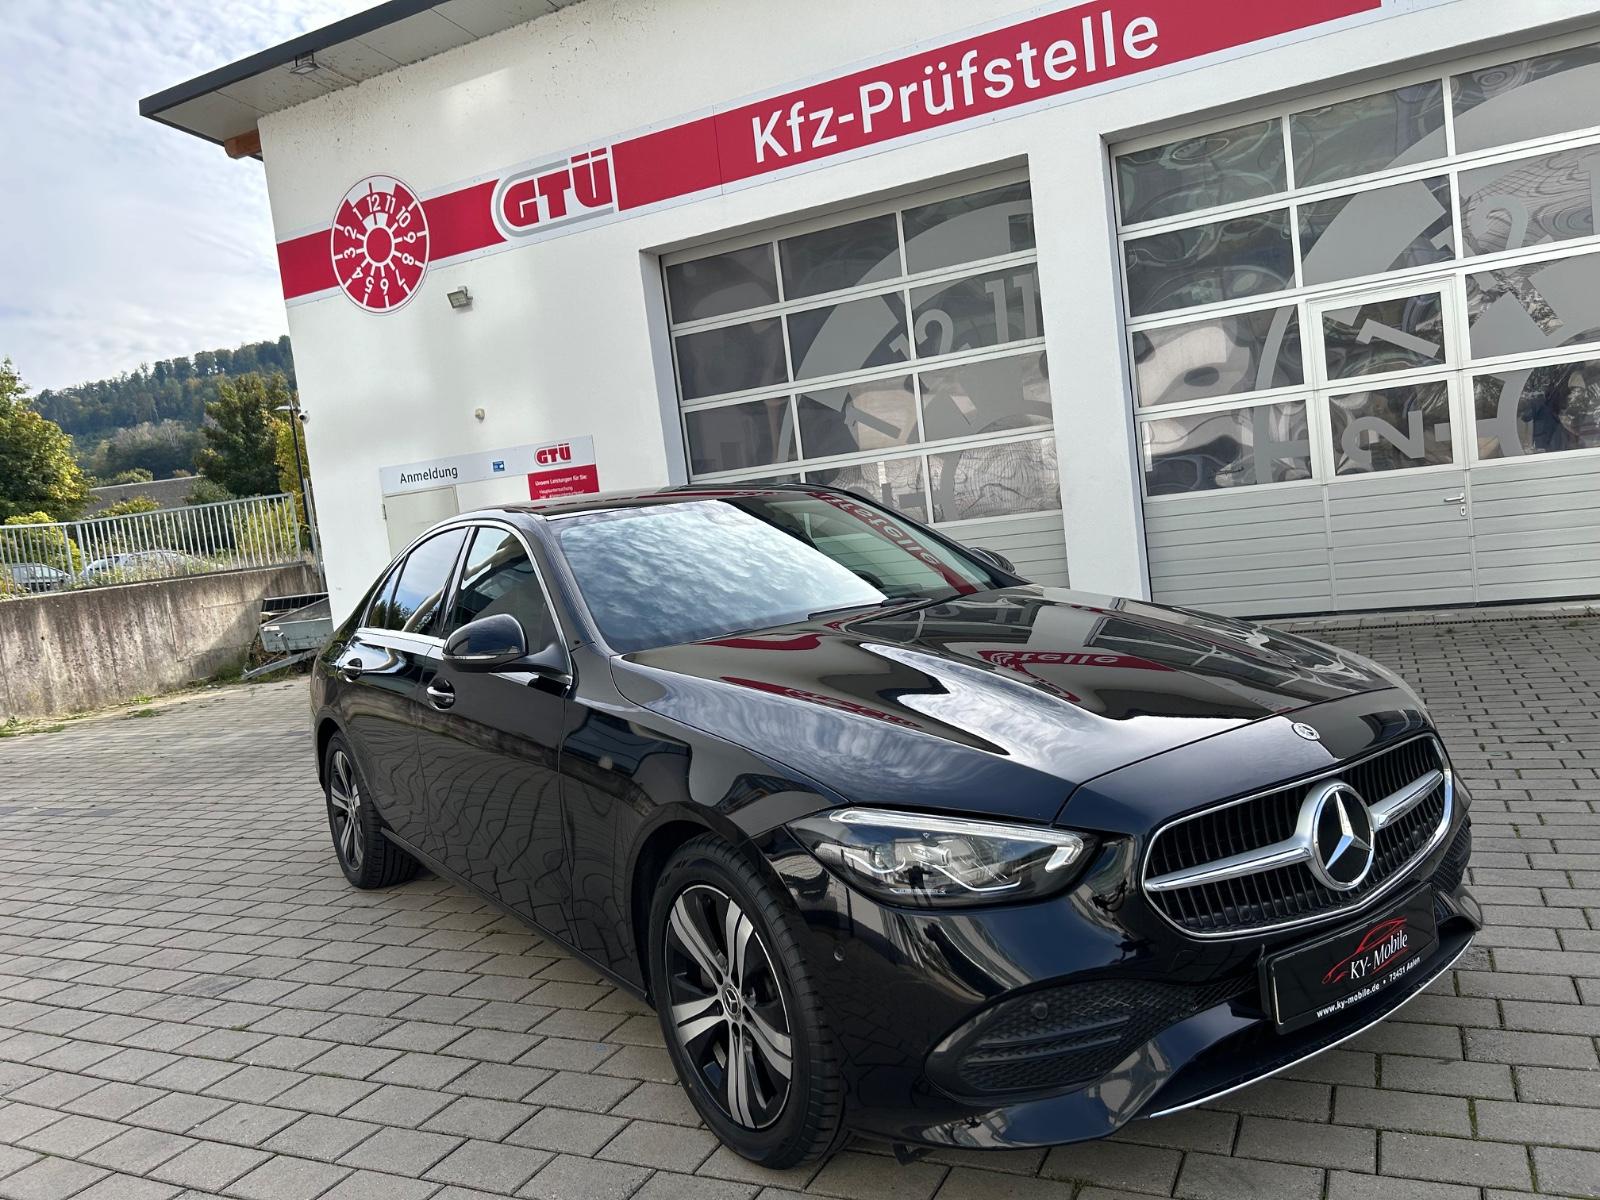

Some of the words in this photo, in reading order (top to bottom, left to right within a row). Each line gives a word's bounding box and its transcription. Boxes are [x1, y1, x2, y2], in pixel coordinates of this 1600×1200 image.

[752, 11, 1159, 163] Kfz-Prüfstelle
[503, 148, 615, 228] GTÜ
[367, 194, 381, 212] 12
[385, 195, 396, 214] 11
[396, 206, 411, 227] 10
[344, 226, 357, 239] 2
[344, 247, 356, 258] 3
[402, 253, 414, 265] 8
[536, 443, 571, 464] GTÜ
[400, 466, 458, 484] Anmeldung
[1316, 983, 1380, 1018] www.ky-mobile.de
[1389, 967, 1406, 982] 73431
[1406, 956, 1421, 972] Aalen
